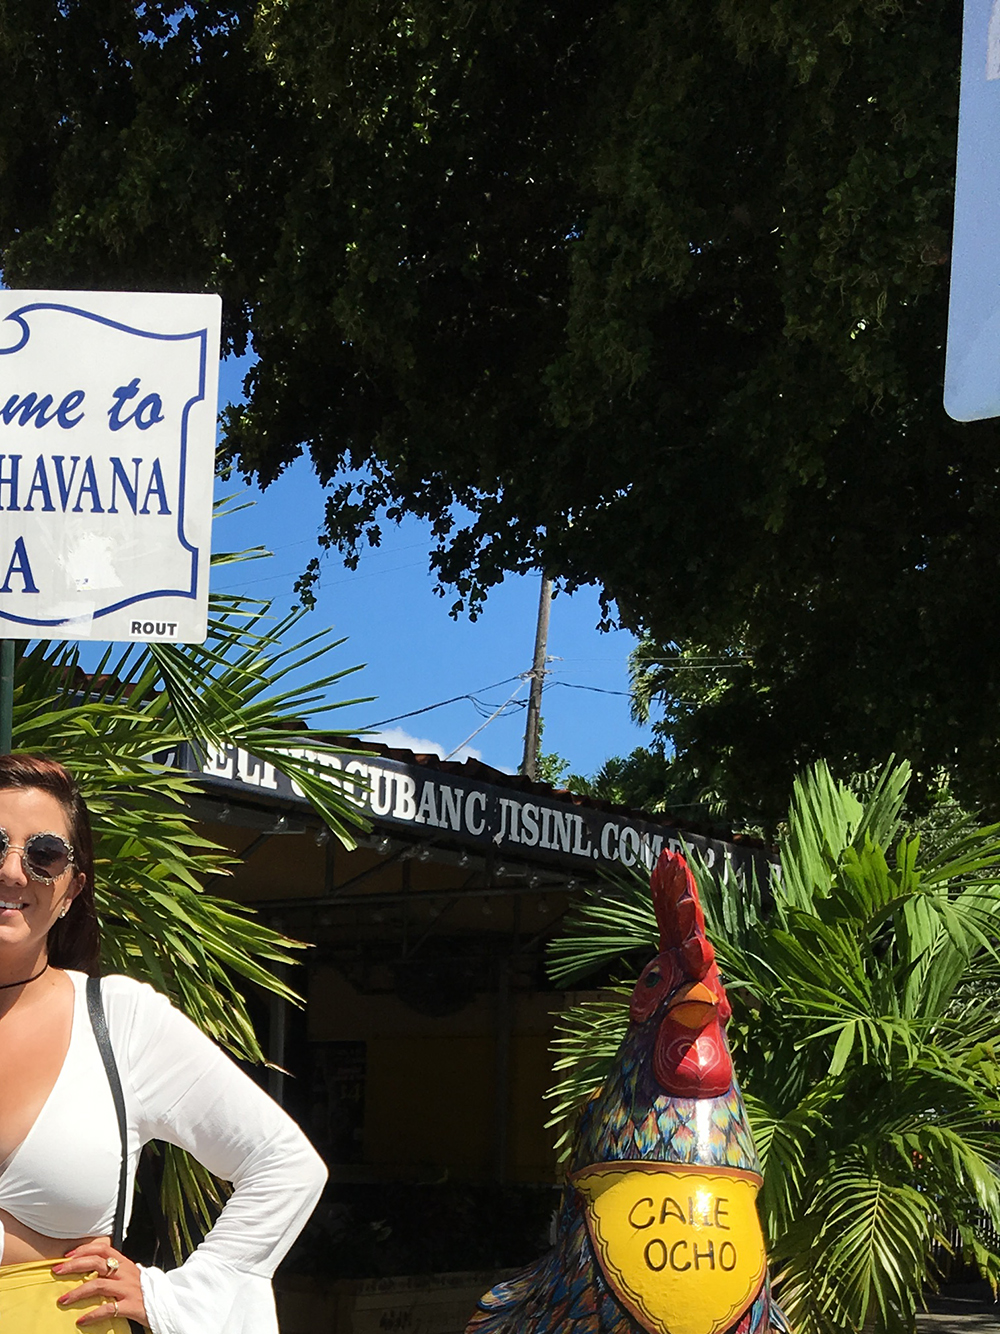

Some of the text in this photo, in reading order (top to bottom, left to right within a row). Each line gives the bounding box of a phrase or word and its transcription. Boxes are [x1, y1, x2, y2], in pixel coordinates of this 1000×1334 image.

[108, 377, 165, 431] to
[131, 621, 178, 636] ROUT
[644, 1238, 737, 1272] OCHO
